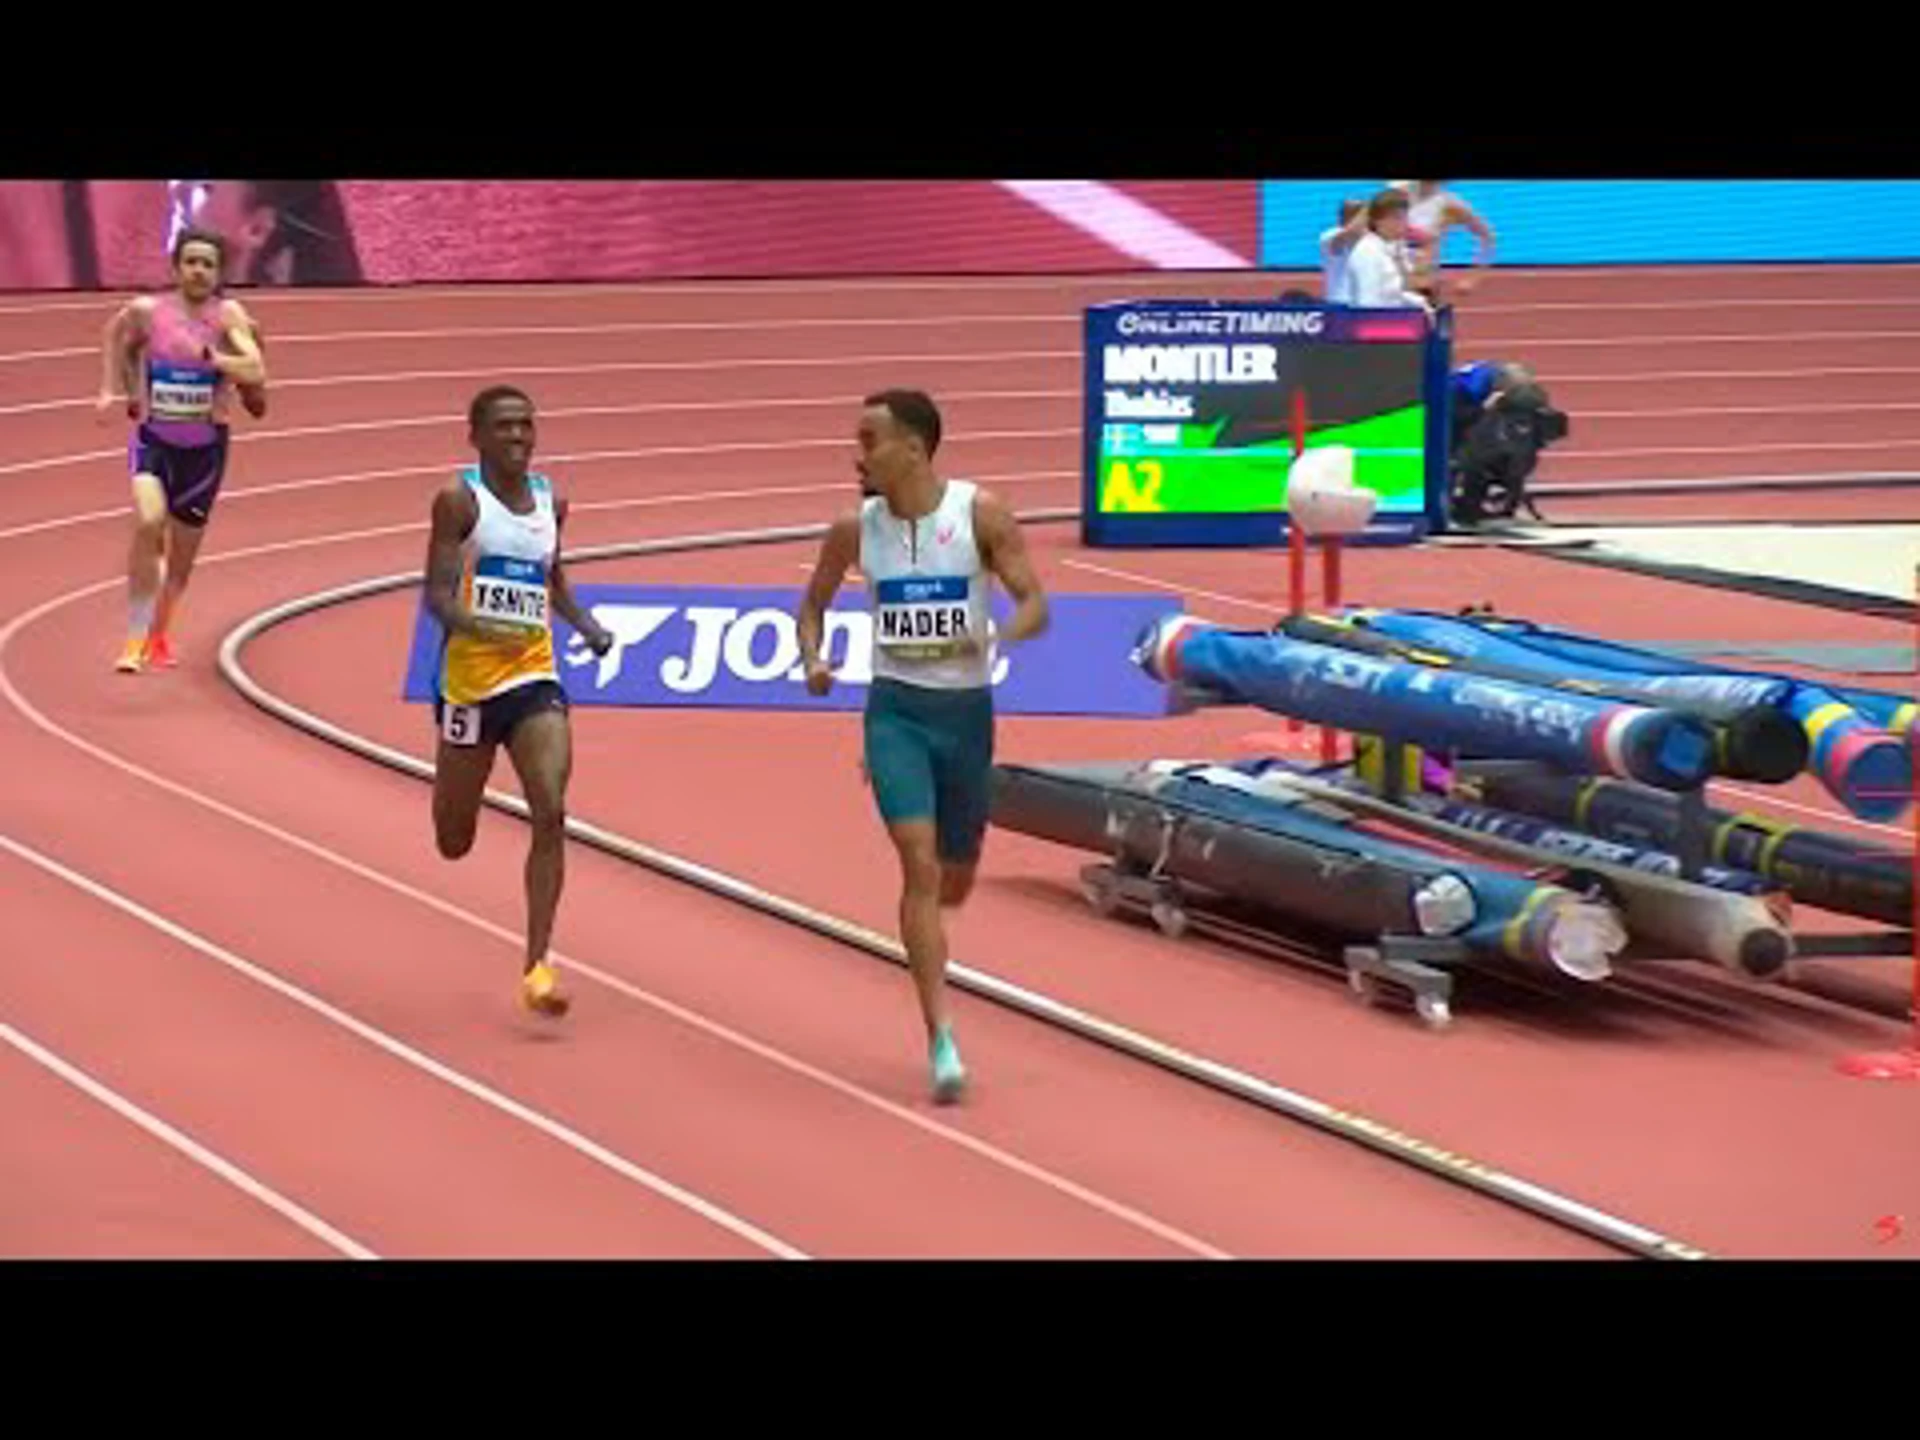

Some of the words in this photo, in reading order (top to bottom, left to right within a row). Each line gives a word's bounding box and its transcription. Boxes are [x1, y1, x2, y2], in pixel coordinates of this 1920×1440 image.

[1104, 344, 1278, 382] MONTLER
[1103, 461, 1163, 512] A2
[882, 608, 968, 638] NADER
[451, 707, 468, 740] 5
